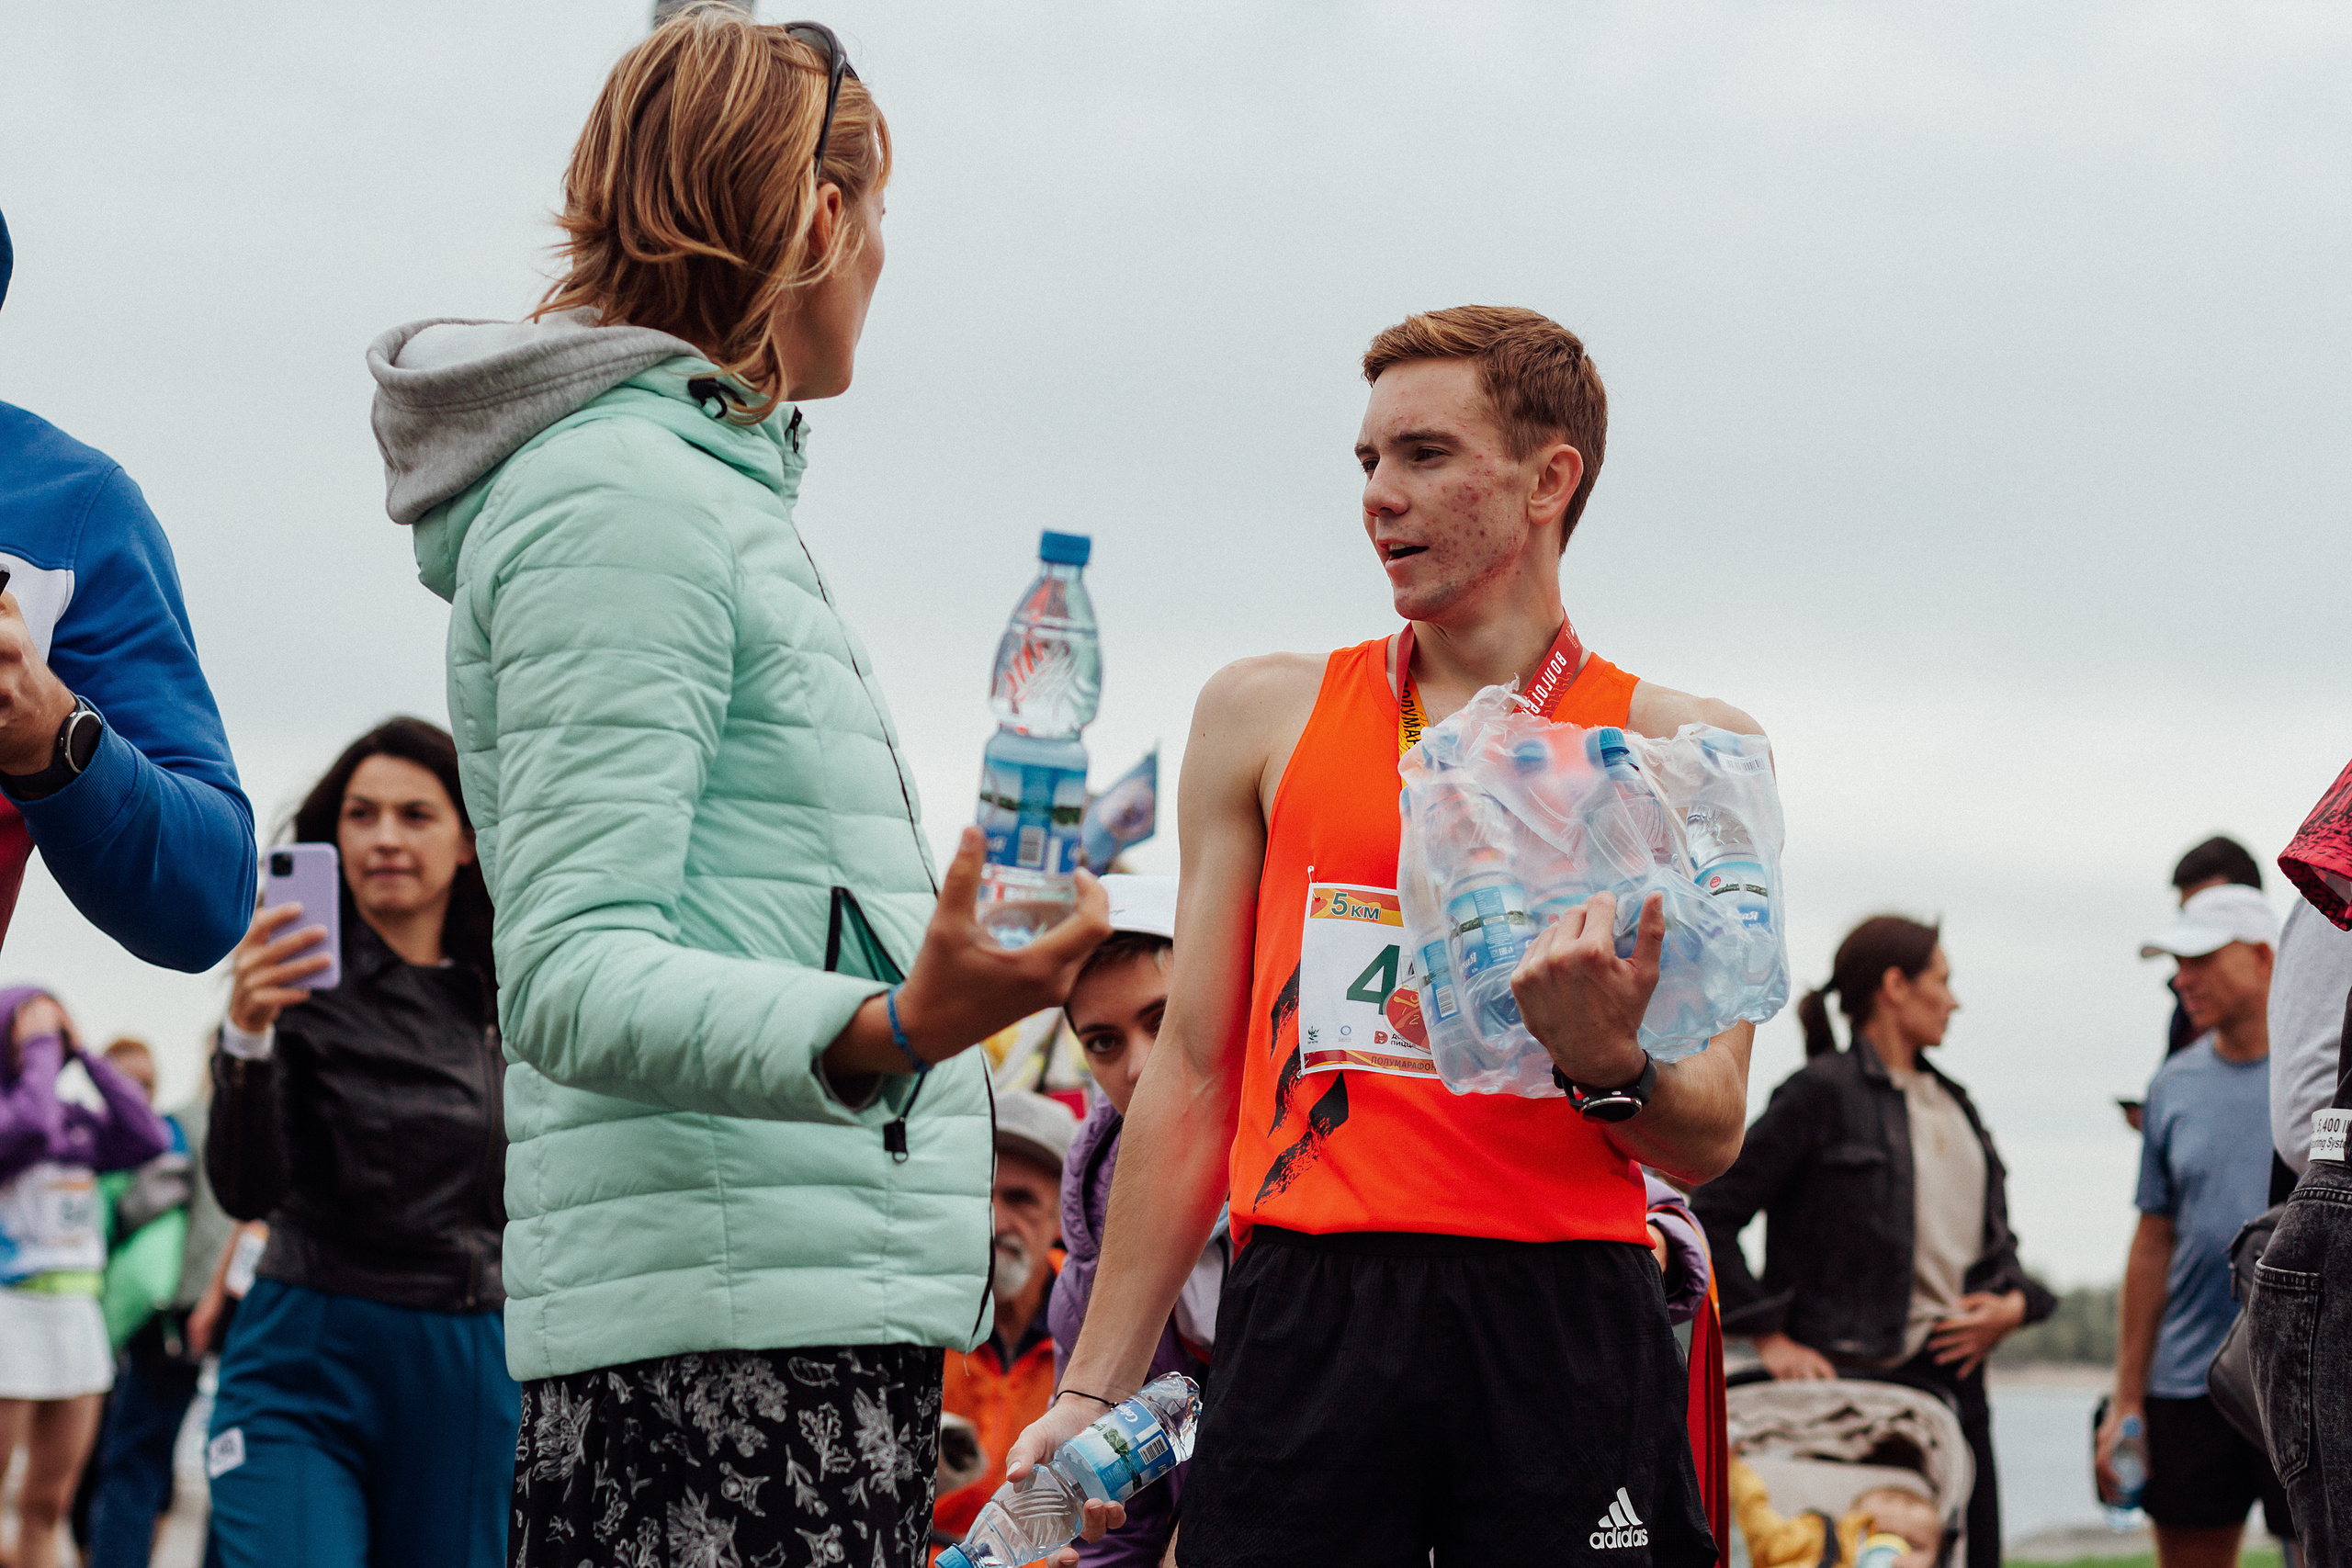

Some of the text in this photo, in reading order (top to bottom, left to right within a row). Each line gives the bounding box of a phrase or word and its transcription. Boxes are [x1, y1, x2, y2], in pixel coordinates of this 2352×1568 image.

[1331, 892, 1348, 916] 5
[1346, 943, 1400, 1015] 4
[1589, 1527, 1648, 1550] adidas
